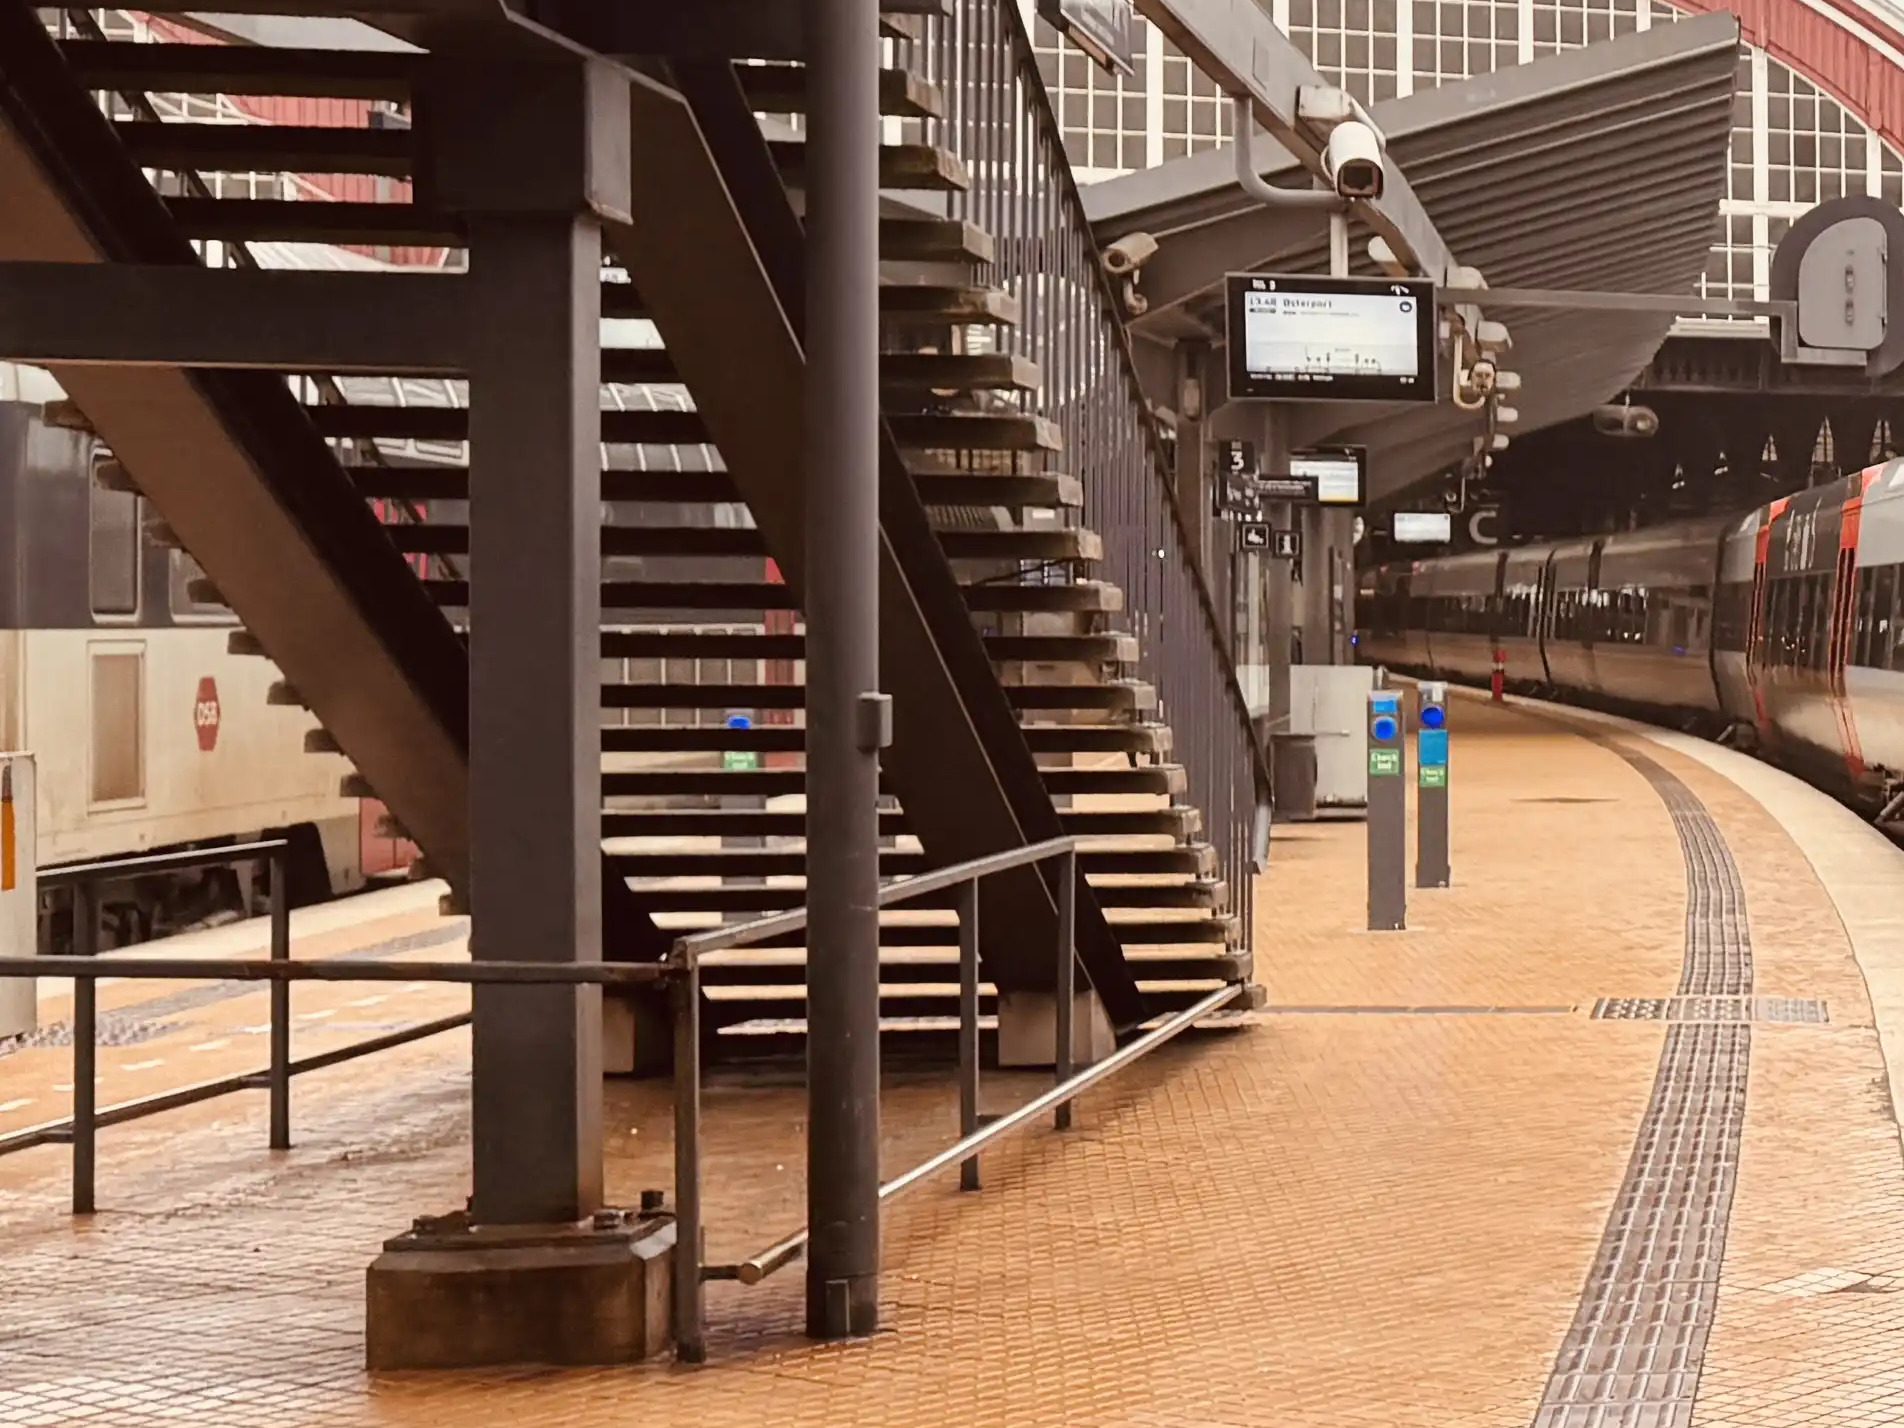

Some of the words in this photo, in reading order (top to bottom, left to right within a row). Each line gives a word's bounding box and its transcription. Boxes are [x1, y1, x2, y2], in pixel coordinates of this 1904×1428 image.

[1231, 451, 1244, 470] 3
[1469, 510, 1498, 544] C
[197, 700, 218, 726] DSB
